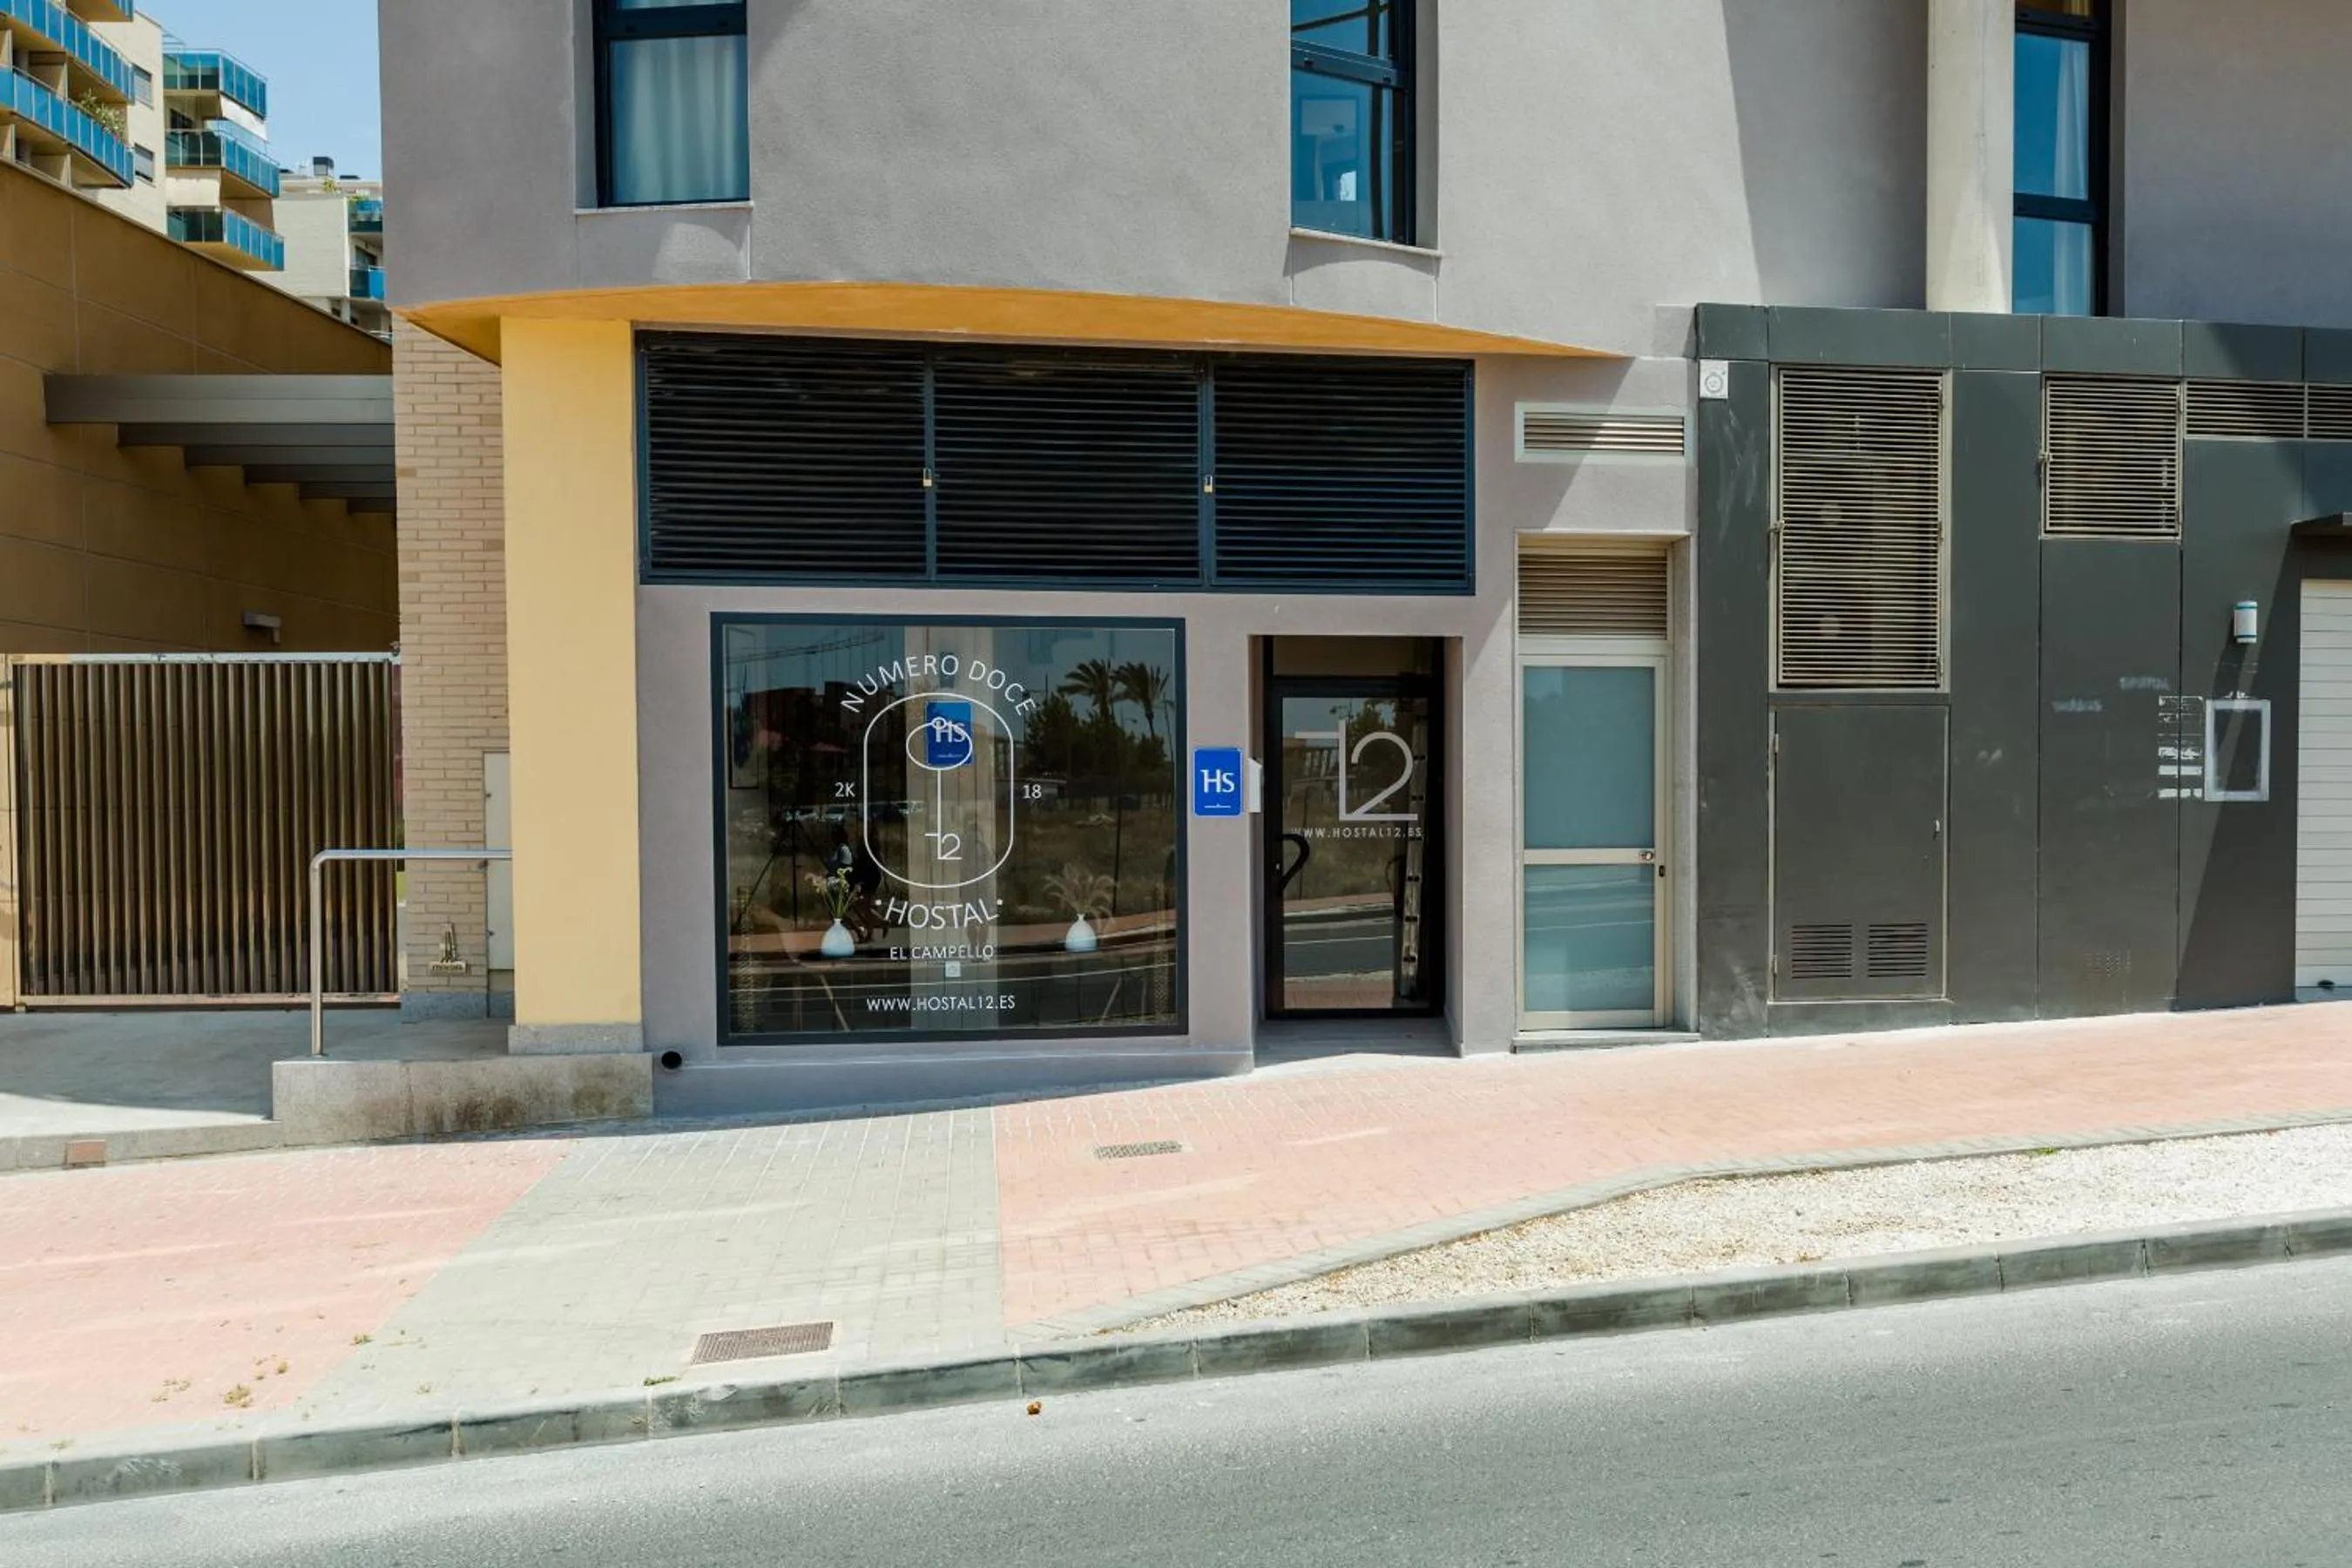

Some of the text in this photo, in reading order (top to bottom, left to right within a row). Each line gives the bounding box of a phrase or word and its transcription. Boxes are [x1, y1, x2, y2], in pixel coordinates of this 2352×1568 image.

[840, 654, 1036, 716] NUMERO DOCE
[1294, 719, 1418, 821] 12
[834, 781, 855, 798] 2K
[1023, 783, 1042, 800] 18
[885, 896, 999, 929] HOSTAL
[889, 944, 995, 960] EL CAMPELLO
[866, 995, 1016, 1012] WWW.HOSTAL12.ES
